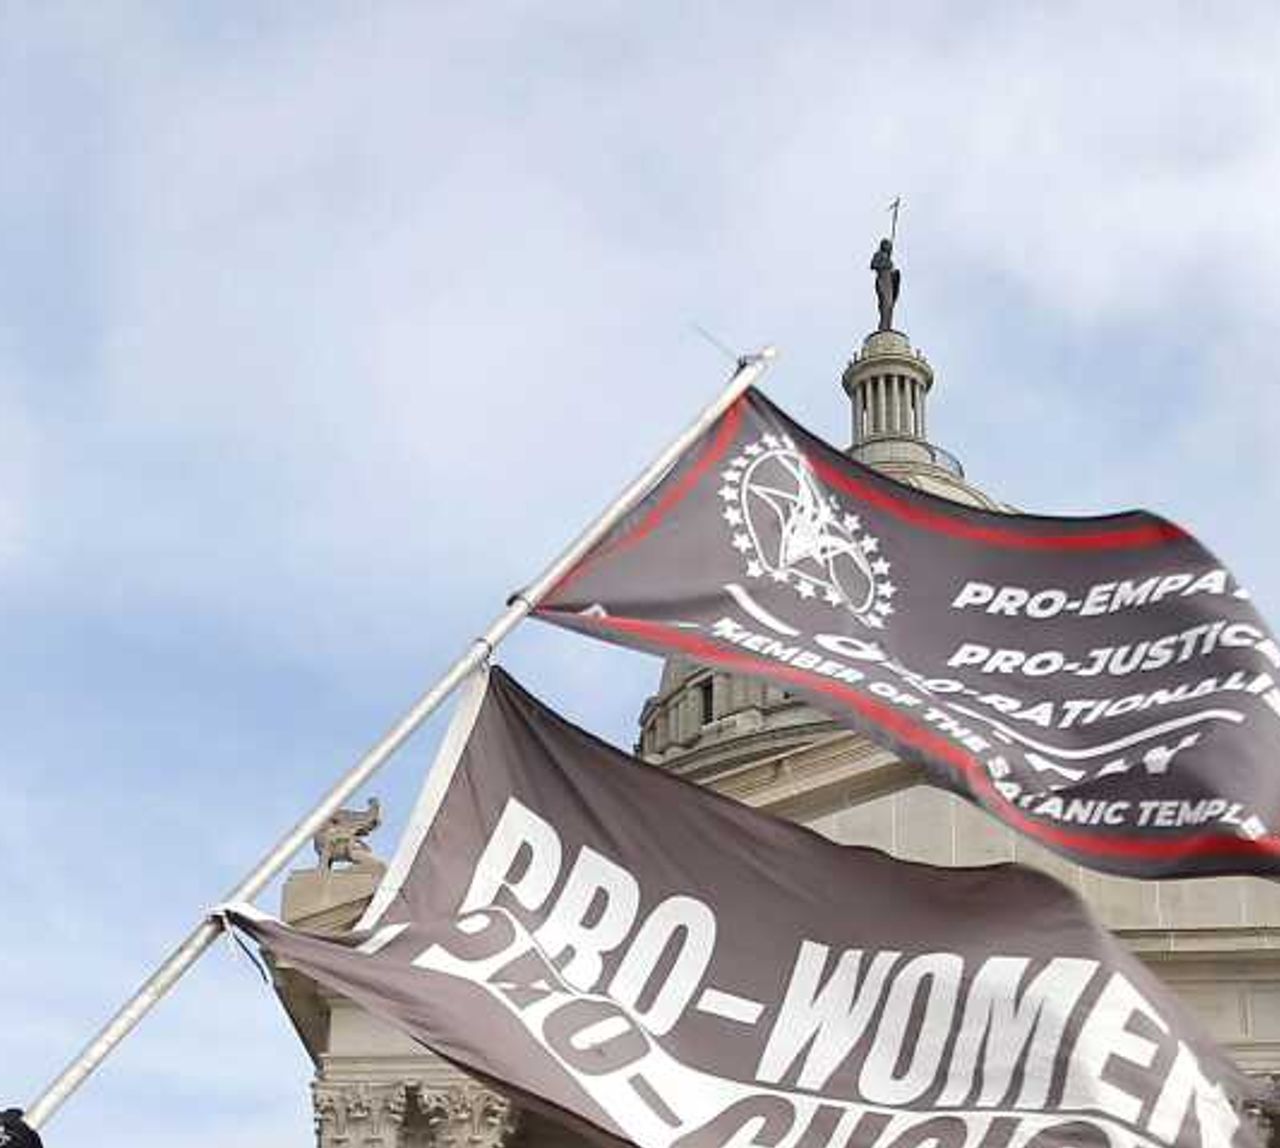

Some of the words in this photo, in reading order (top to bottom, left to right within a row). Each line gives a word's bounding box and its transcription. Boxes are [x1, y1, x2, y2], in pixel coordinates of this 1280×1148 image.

[952, 570, 1251, 617] PRO-EMPA
[713, 617, 865, 684] MEMBER
[869, 682, 923, 707] OF
[923, 707, 991, 752] THE
[1137, 799, 1267, 842] TEMPLE
